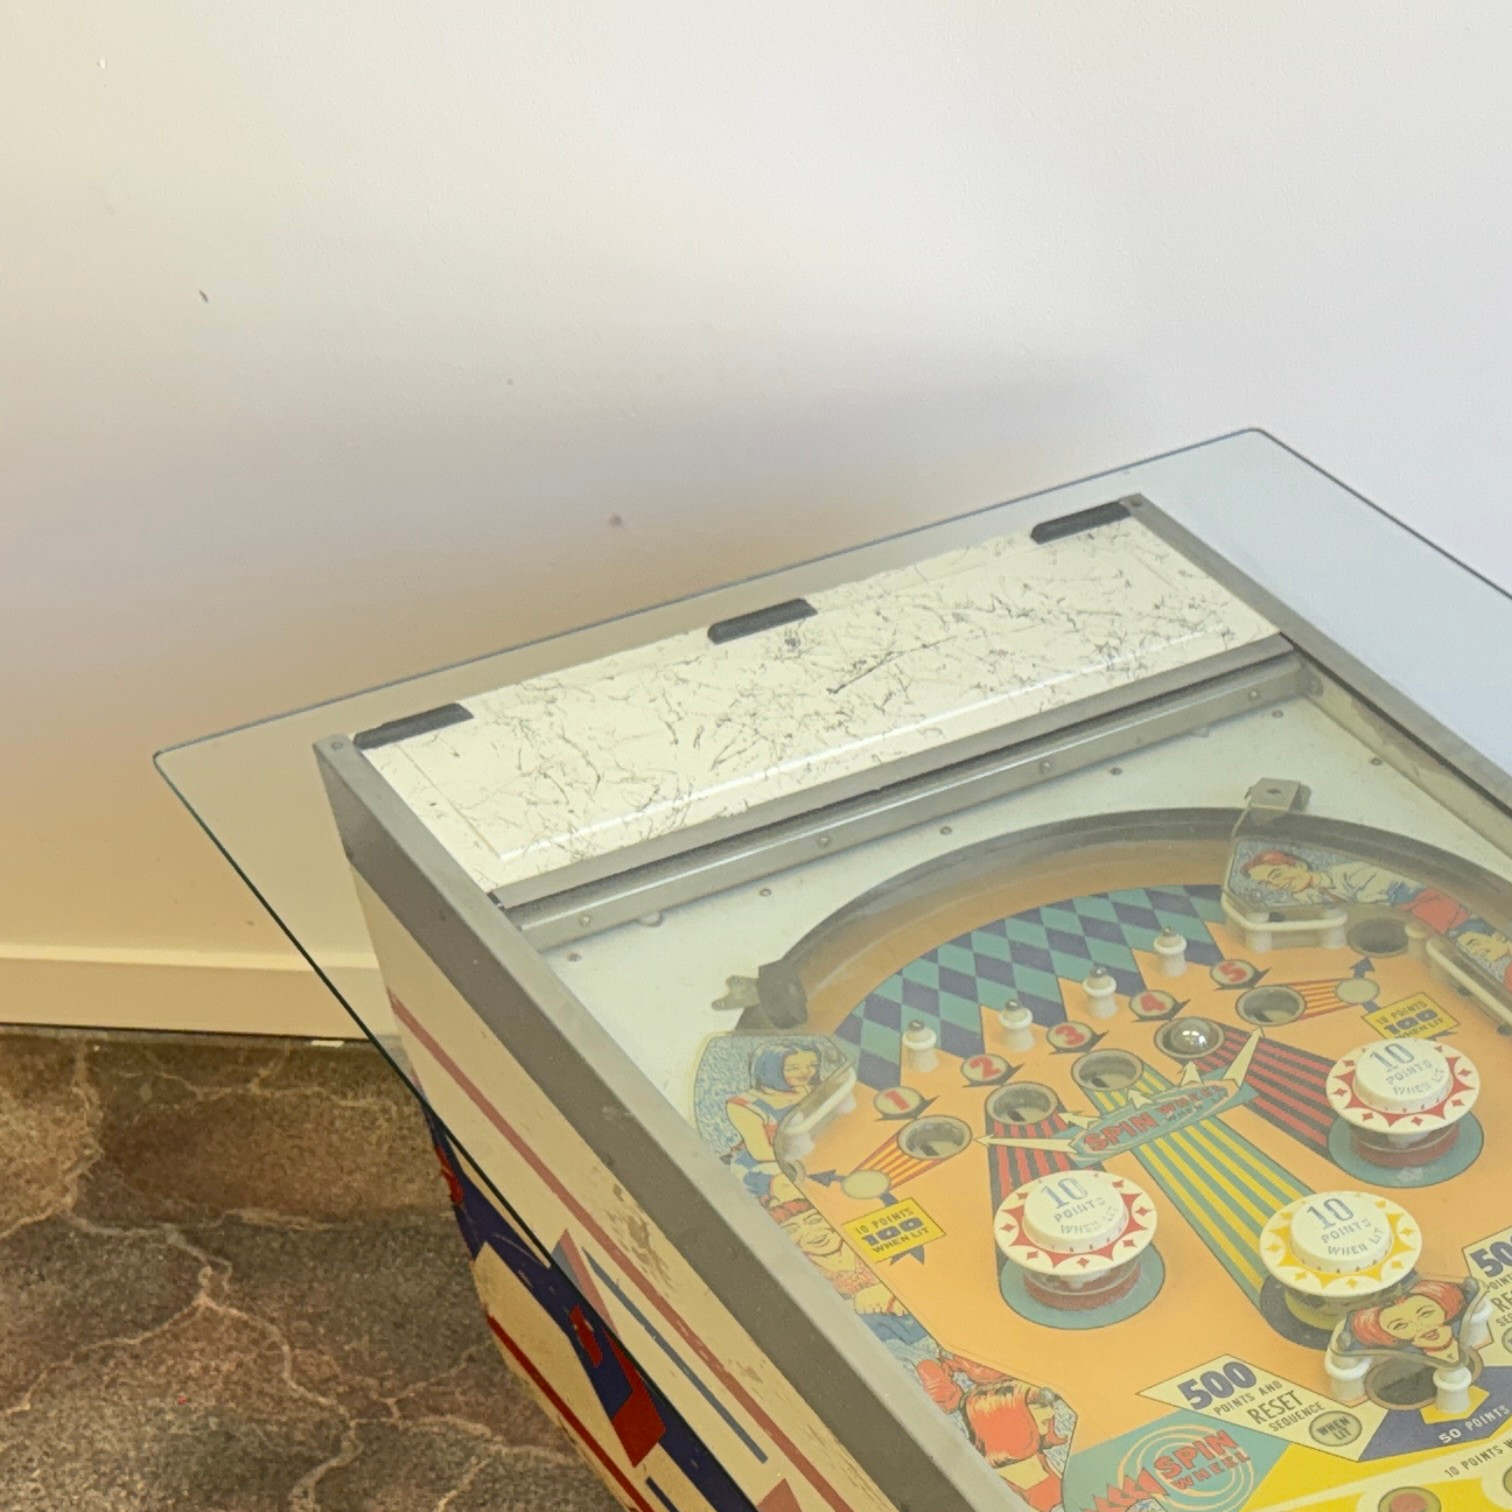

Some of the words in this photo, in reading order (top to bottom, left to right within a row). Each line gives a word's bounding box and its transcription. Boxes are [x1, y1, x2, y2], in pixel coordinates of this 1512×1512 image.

[1218, 962, 1248, 983] 5
[1384, 1009, 1438, 1035] 100
[1390, 1000, 1428, 1018] POINTS
[1055, 1024, 1086, 1046] 3
[969, 1056, 1002, 1079] 2
[1369, 1043, 1415, 1073] 10
[1385, 1060, 1434, 1085] POINTS
[883, 1090, 910, 1111] 1
[1083, 1112, 1158, 1152] SPIN
[1040, 1177, 1089, 1209] 10
[872, 1206, 914, 1228] POINTS
[1053, 1197, 1107, 1223] POINTS
[1307, 1198, 1354, 1230] 10
[861, 1216, 925, 1247] 100
[871, 1235, 911, 1254] WHEN
[911, 1226, 930, 1239] LIT
[1320, 1218, 1372, 1243] POINTS
[1327, 1243, 1368, 1256] WHEN
[1369, 1227, 1385, 1244] LIT
[1176, 1361, 1258, 1411] 500
[1213, 1391, 1256, 1416] POINTS
[1258, 1379, 1284, 1397] AND
[1246, 1389, 1304, 1426] RESET
[1267, 1400, 1327, 1432] SEQUENCE
[1315, 1415, 1351, 1438] WHEN
[1331, 1427, 1352, 1441] LIT
[1438, 1427, 1462, 1444] 50
[1464, 1404, 1511, 1431] POINTS
[1153, 1429, 1240, 1482] SPIN
[1443, 1466, 1460, 1478] 10
[1460, 1445, 1504, 1471] POINTS
[1169, 1451, 1252, 1491] WHEEL
